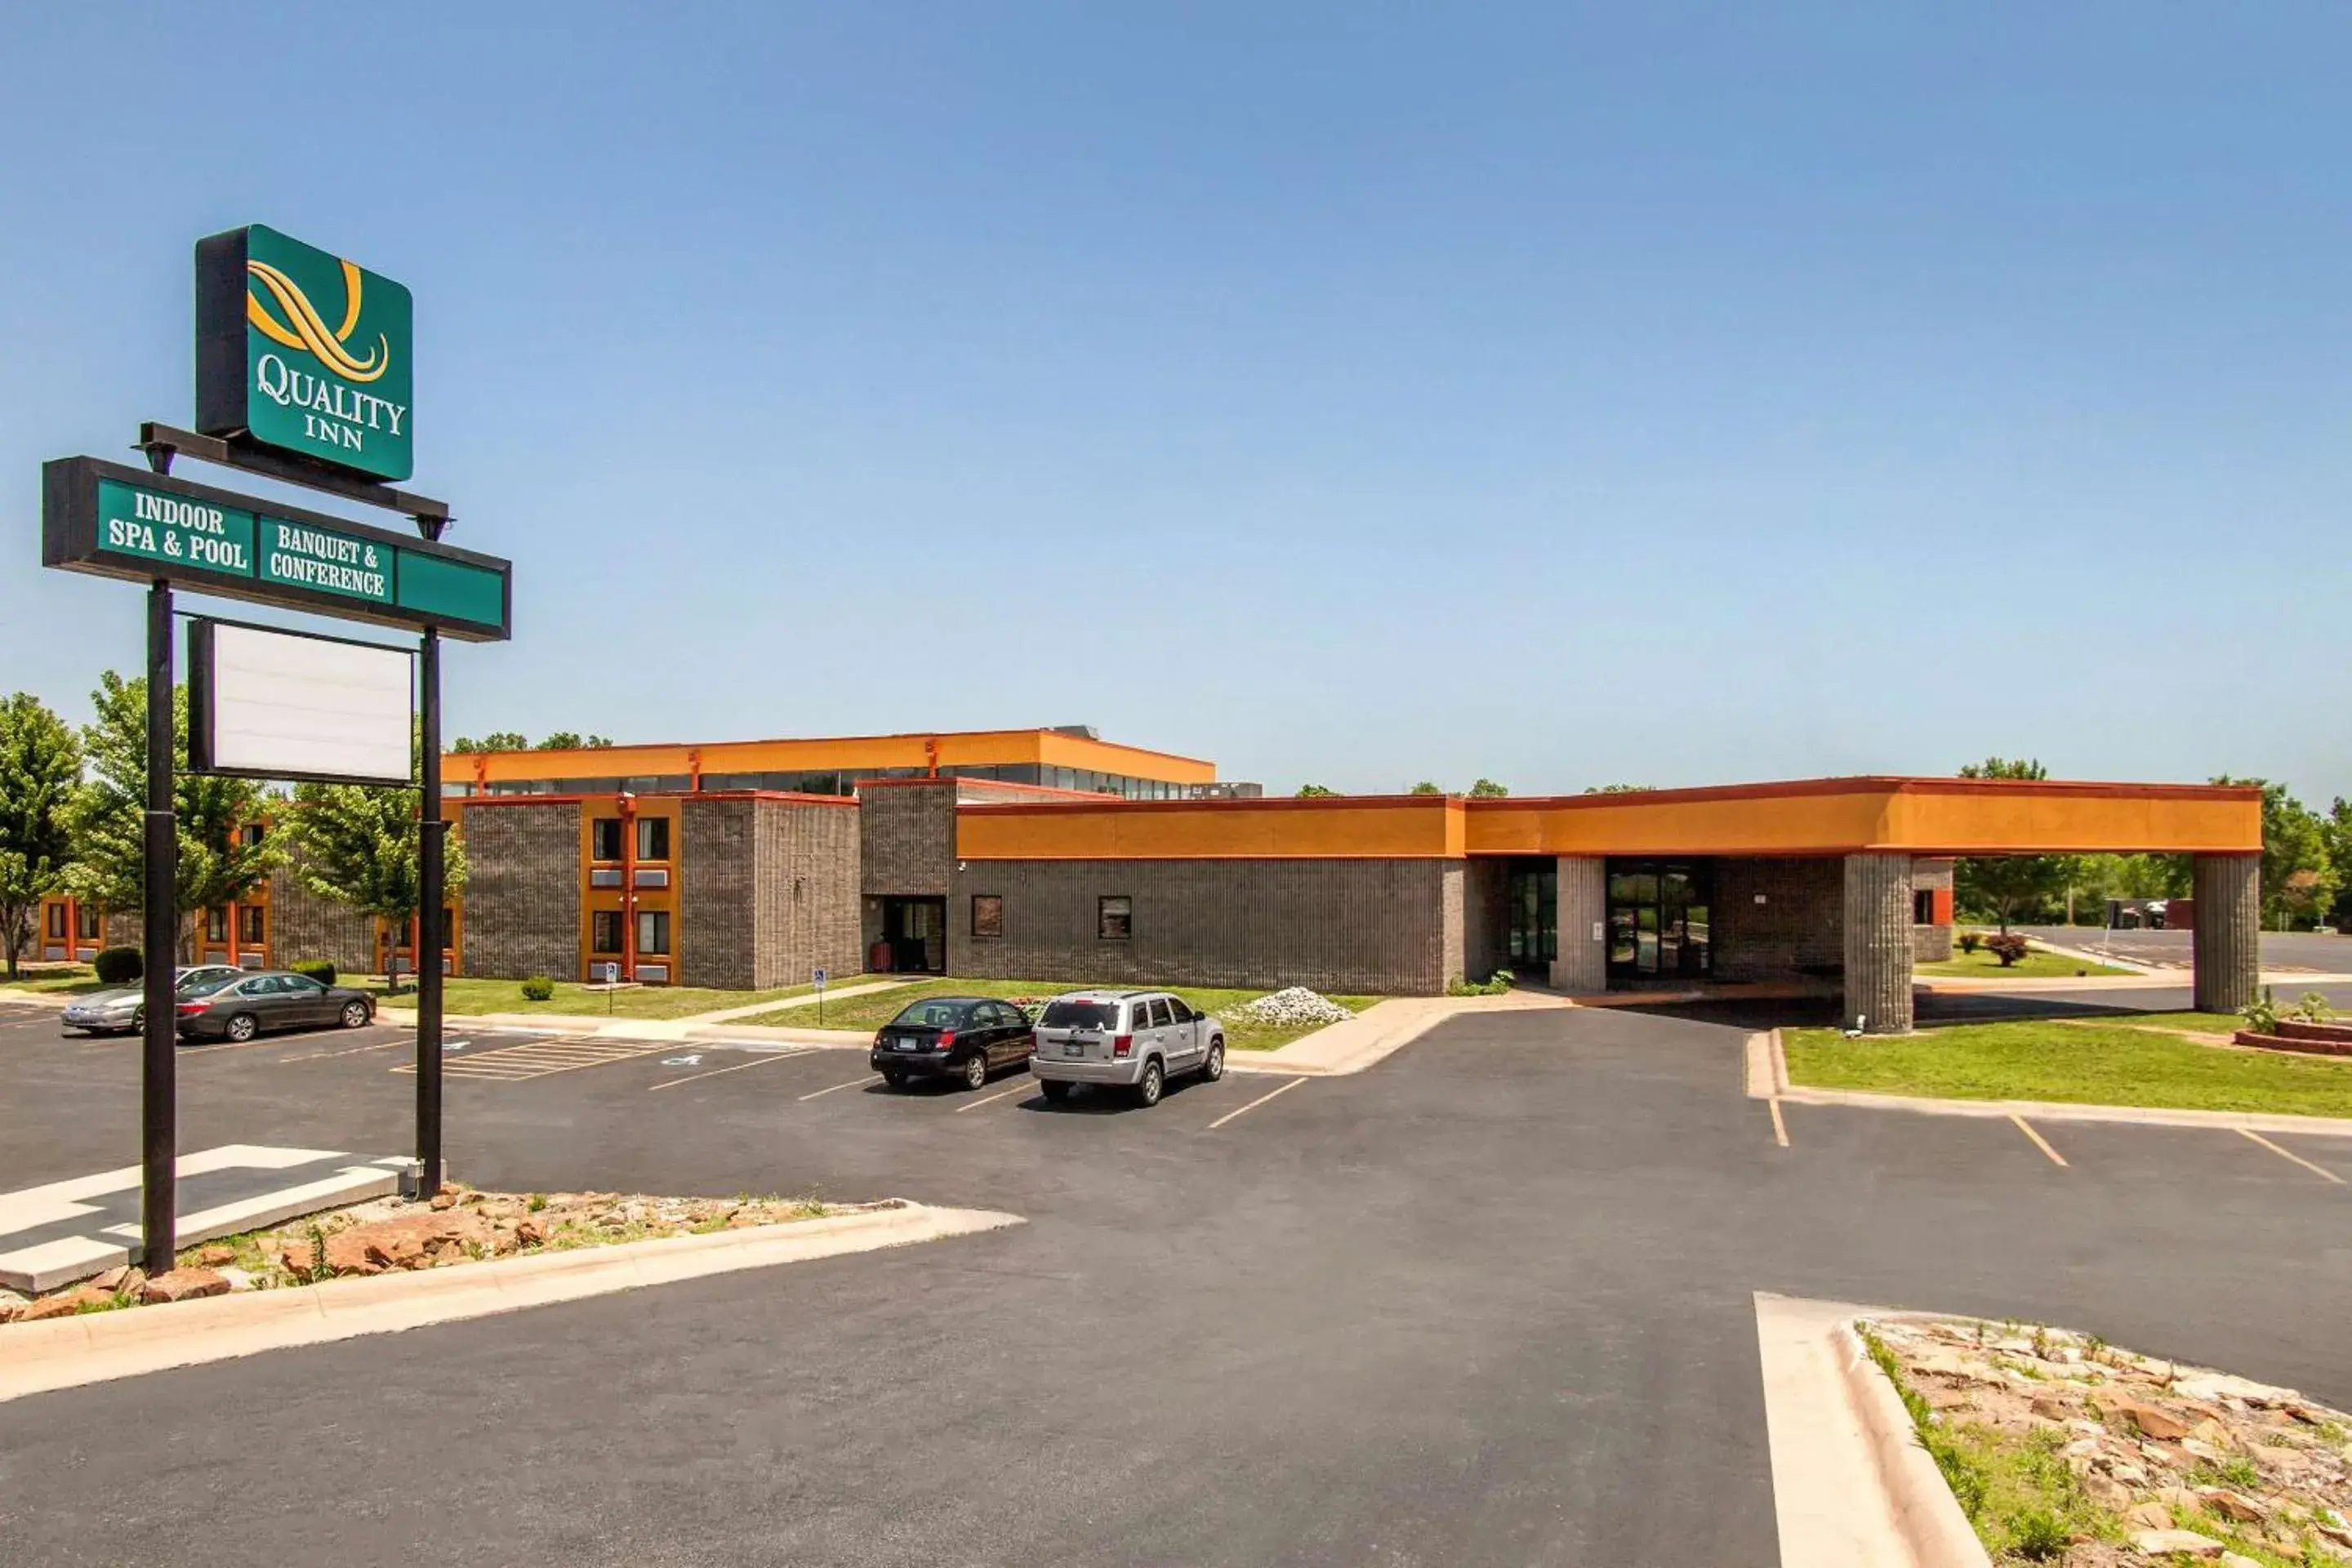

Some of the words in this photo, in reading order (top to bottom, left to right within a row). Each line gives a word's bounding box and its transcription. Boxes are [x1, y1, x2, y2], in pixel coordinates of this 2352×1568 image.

[257, 354, 406, 435] QUALITY
[305, 414, 363, 452] INN
[135, 492, 225, 535] INDOOR
[109, 519, 157, 552] SPA
[163, 531, 183, 557] &
[189, 535, 247, 568] POOL
[278, 524, 359, 564] BANQUET
[364, 545, 378, 568] &
[270, 552, 385, 596] CONFERENCE
